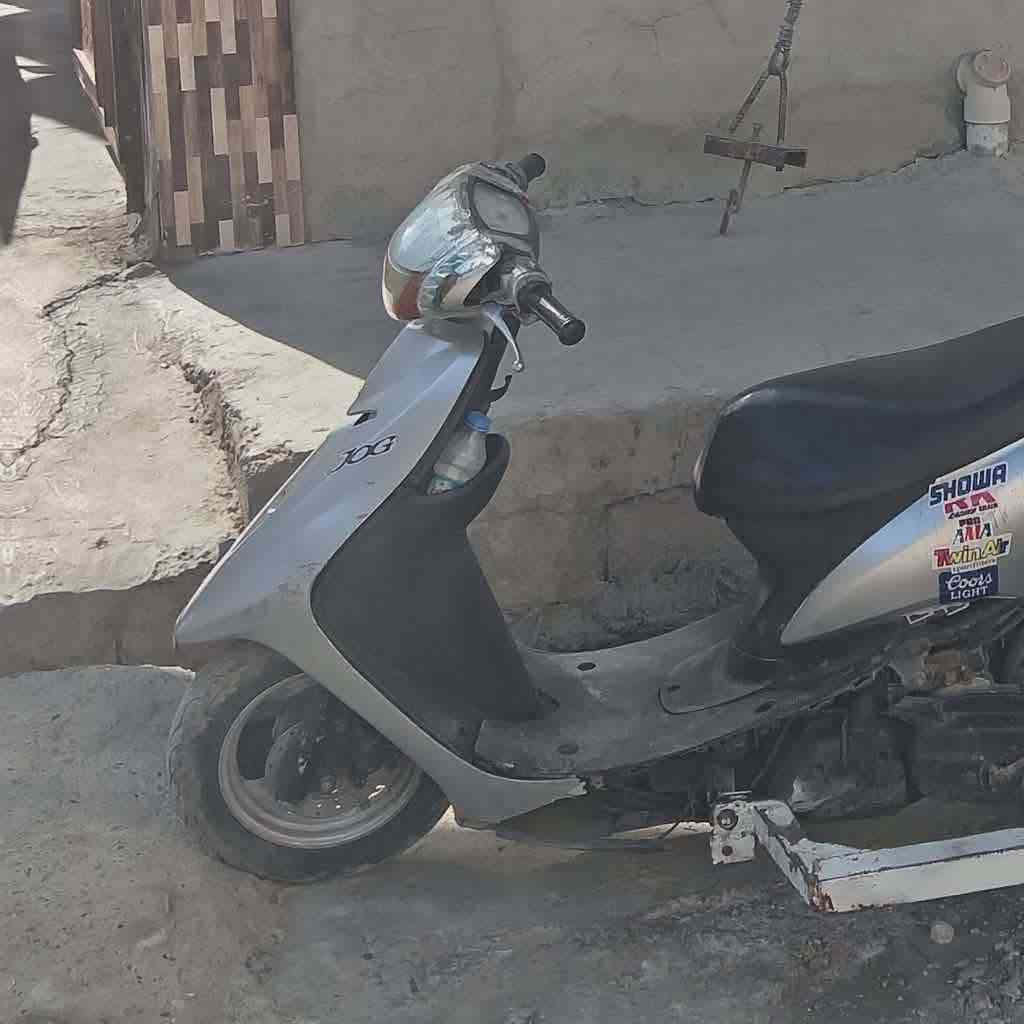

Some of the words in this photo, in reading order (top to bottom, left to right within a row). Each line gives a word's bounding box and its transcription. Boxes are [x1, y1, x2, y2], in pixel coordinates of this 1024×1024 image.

[329, 435, 397, 474] JOG
[929, 463, 1007, 506] SHOWA
[945, 573, 993, 591] Coors
[950, 586, 989, 601] LIGHT
